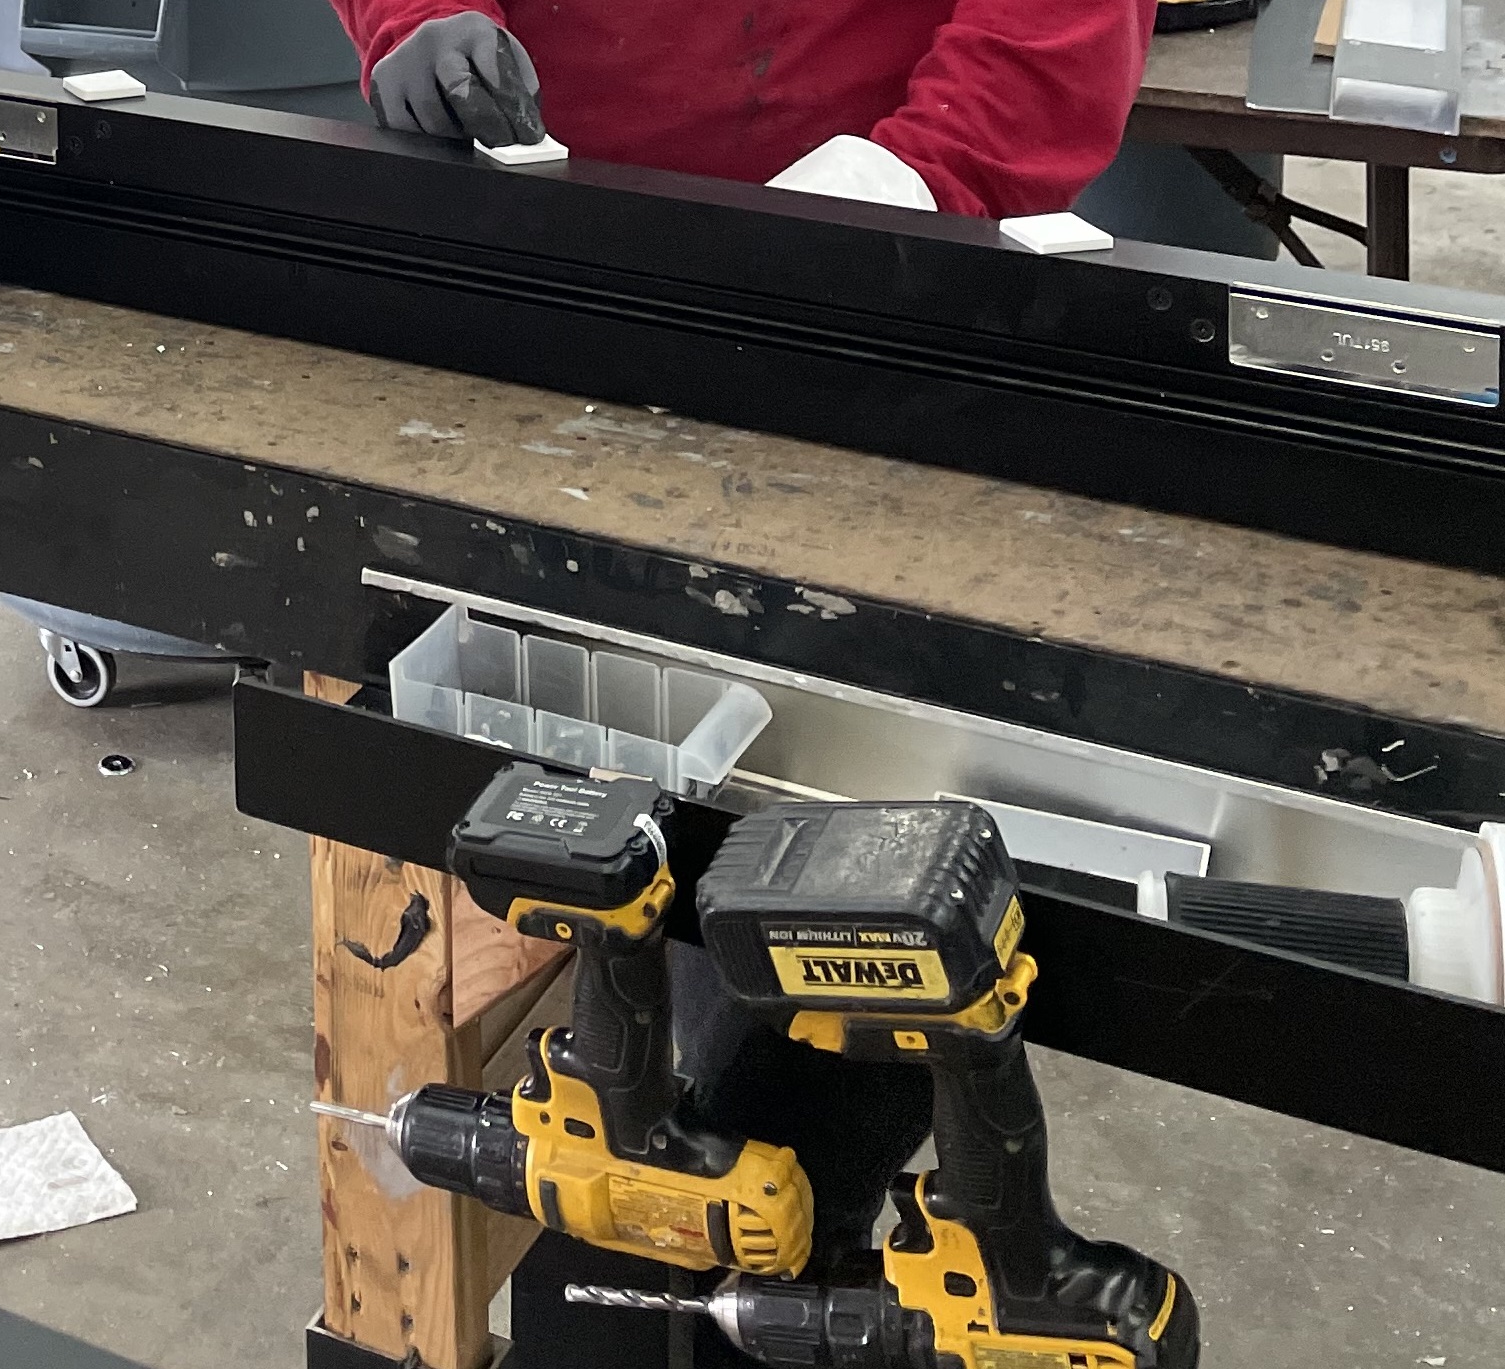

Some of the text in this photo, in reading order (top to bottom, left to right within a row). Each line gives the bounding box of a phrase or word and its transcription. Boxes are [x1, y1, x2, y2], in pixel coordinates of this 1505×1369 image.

[769, 930, 793, 941] ION
[797, 930, 852, 943] LITHIUM
[801, 958, 923, 985] DEWALT
